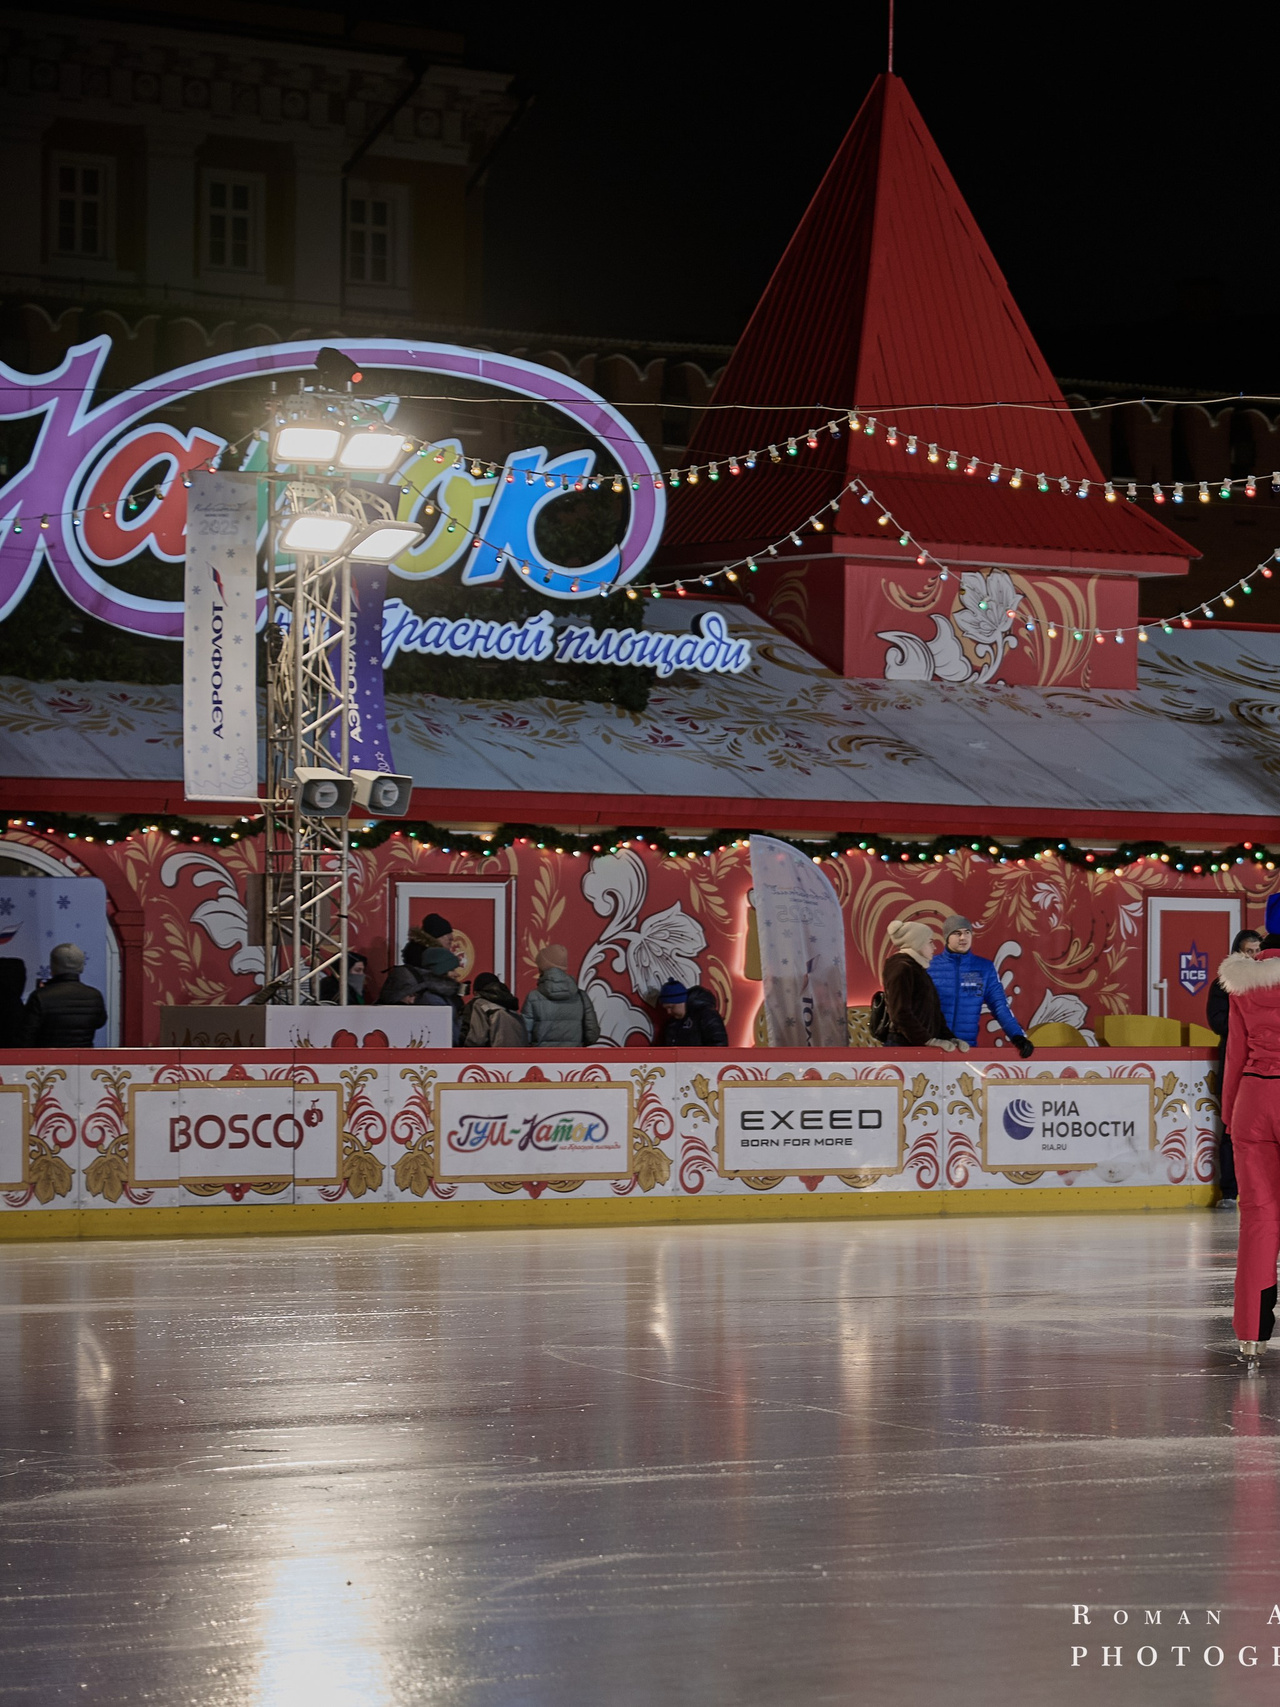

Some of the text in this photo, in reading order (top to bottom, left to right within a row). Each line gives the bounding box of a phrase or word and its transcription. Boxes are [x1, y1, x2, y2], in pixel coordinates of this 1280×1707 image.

[556, 611, 751, 677] площади
[211, 601, 225, 740] АЭРОФЛОТ
[1180, 970, 1207, 980] ПСБ
[1041, 1100, 1080, 1117] РИА
[741, 1109, 882, 1131] EXEED
[1041, 1120, 1135, 1138] НОВОСТИ
[169, 1113, 305, 1153] BOSCO
[741, 1137, 853, 1148] BORN FOR MORE
[1041, 1143, 1067, 1151] RIA.RU
